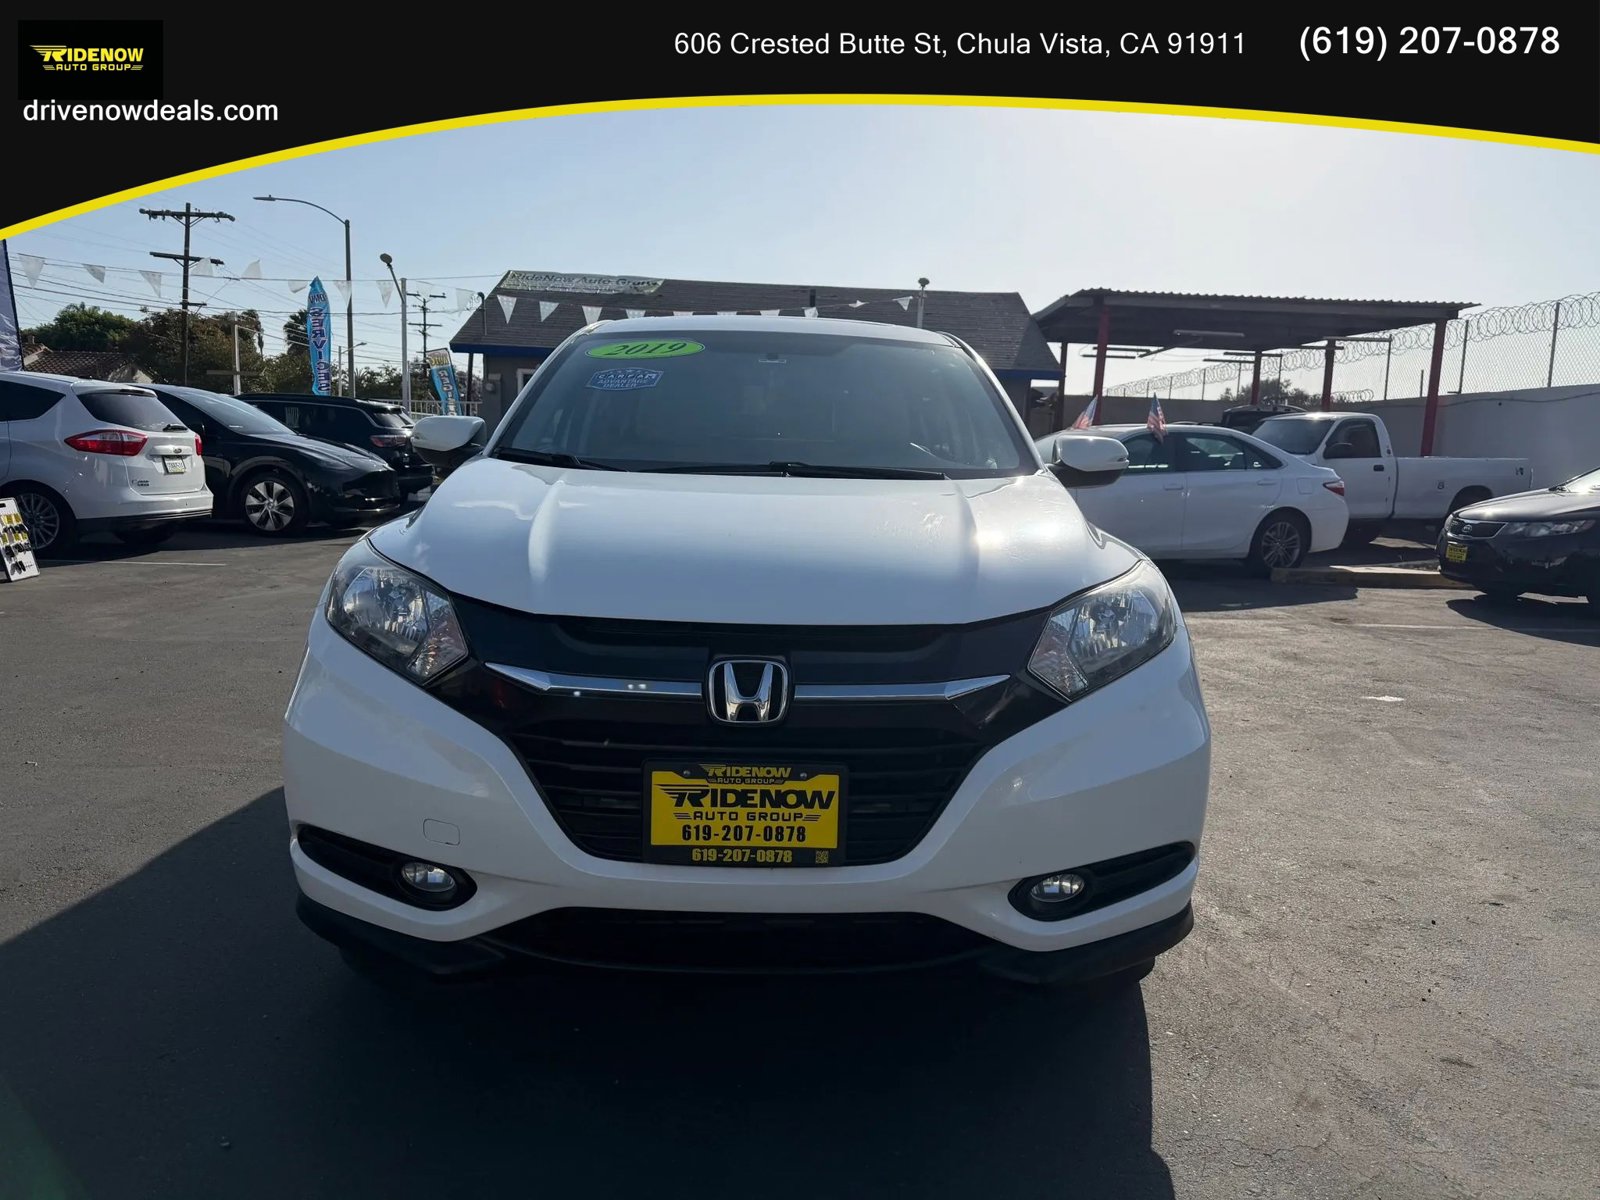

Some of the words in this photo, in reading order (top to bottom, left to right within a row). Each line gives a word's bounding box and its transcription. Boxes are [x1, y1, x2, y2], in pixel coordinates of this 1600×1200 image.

[602, 342, 687, 356] 2019
[700, 764, 792, 778] RIDENOW
[654, 784, 836, 810] RIDENOW
[693, 811, 739, 821] AUTO
[746, 811, 804, 822] GROUP
[681, 824, 807, 843] 619-207-0878
[691, 847, 793, 864] 619-207-0878
